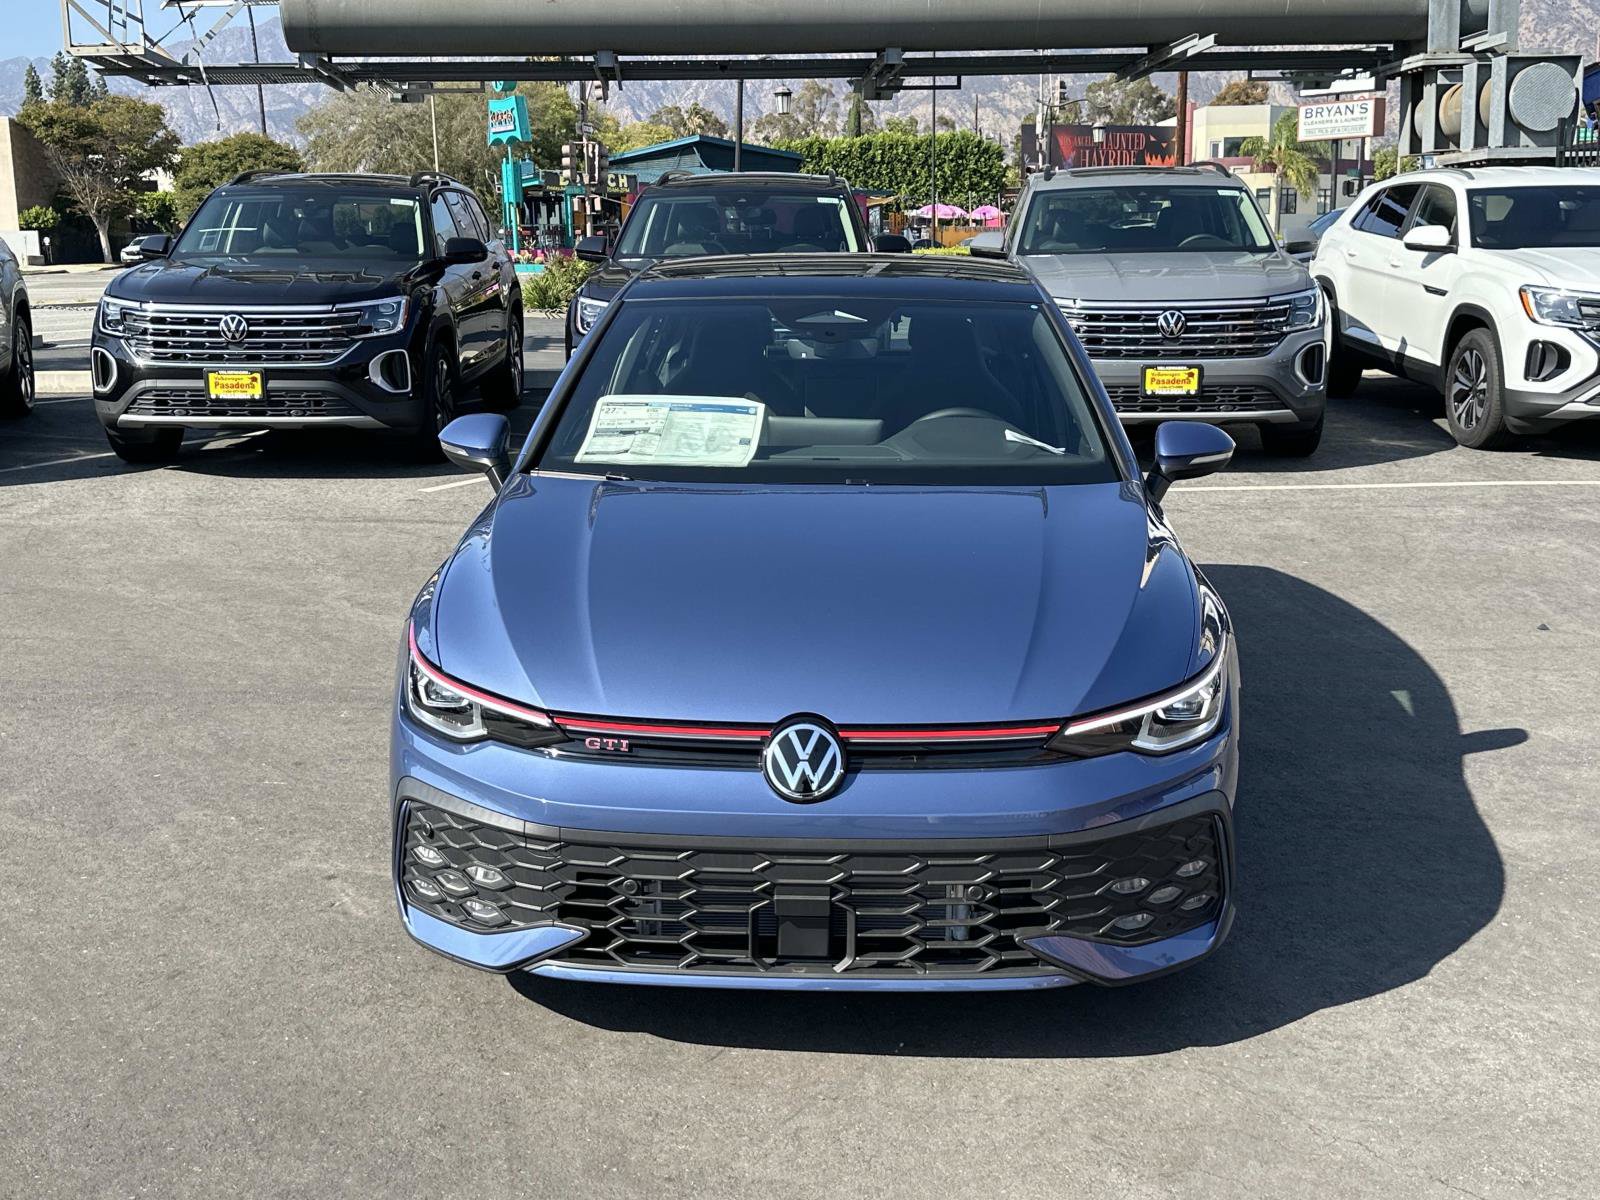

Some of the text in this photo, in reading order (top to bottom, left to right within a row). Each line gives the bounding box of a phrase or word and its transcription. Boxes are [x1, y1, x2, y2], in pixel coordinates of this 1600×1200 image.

[1304, 103, 1369, 118] BRYAN'S
[1080, 148, 1138, 168] HAYRIDE
[214, 381, 256, 390] Pasadena
[1150, 377, 1192, 385] Pasadena
[585, 737, 629, 752] GTI
